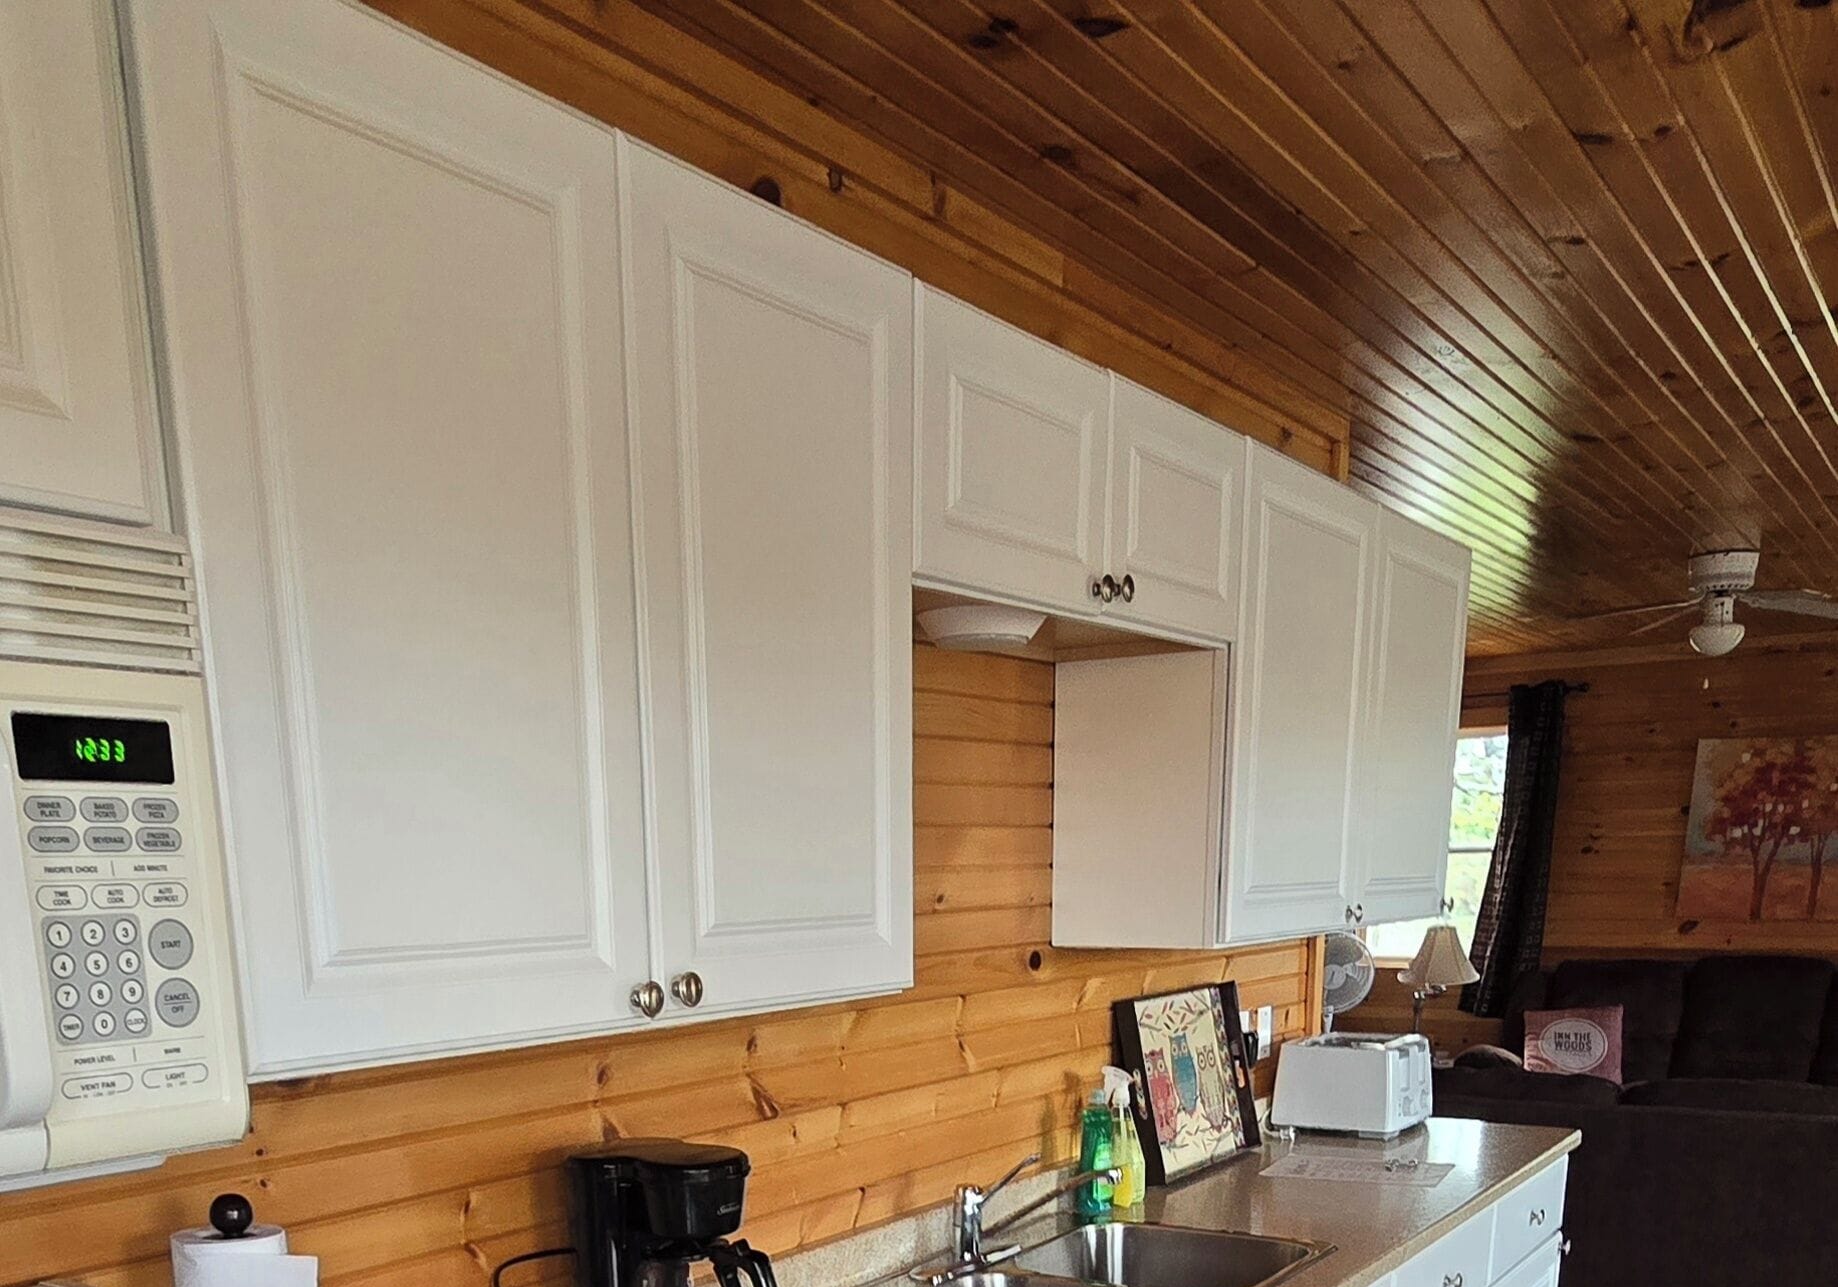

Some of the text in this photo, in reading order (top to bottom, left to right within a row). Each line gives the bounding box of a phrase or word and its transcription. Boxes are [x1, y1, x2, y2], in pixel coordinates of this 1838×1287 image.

[40, 810, 61, 818] PLATE
[39, 836, 70, 844] POPCORN
[56, 931, 62, 941] 1
[89, 929, 97, 939] 2
[122, 927, 129, 938] 3
[161, 940, 181, 949] START
[60, 961, 66, 972] 4
[94, 959, 100, 970] 5
[126, 957, 133, 968] 6
[63, 991, 71, 1001] 7
[97, 989, 104, 999] 8
[129, 987, 136, 997] 9
[164, 993, 191, 1002] CANCEL
[171, 1006, 185, 1014] OFF
[101, 1019, 108, 1029] 0
[127, 1017, 145, 1026] CLOCK
[1554, 1032, 1591, 1040] INN THE
[1554, 1040, 1593, 1051] WOODS
[74, 1055, 116, 1065] POWER LEVEL
[165, 1072, 185, 1080] LIGHT
[80, 1081, 116, 1091] VENT FAN
